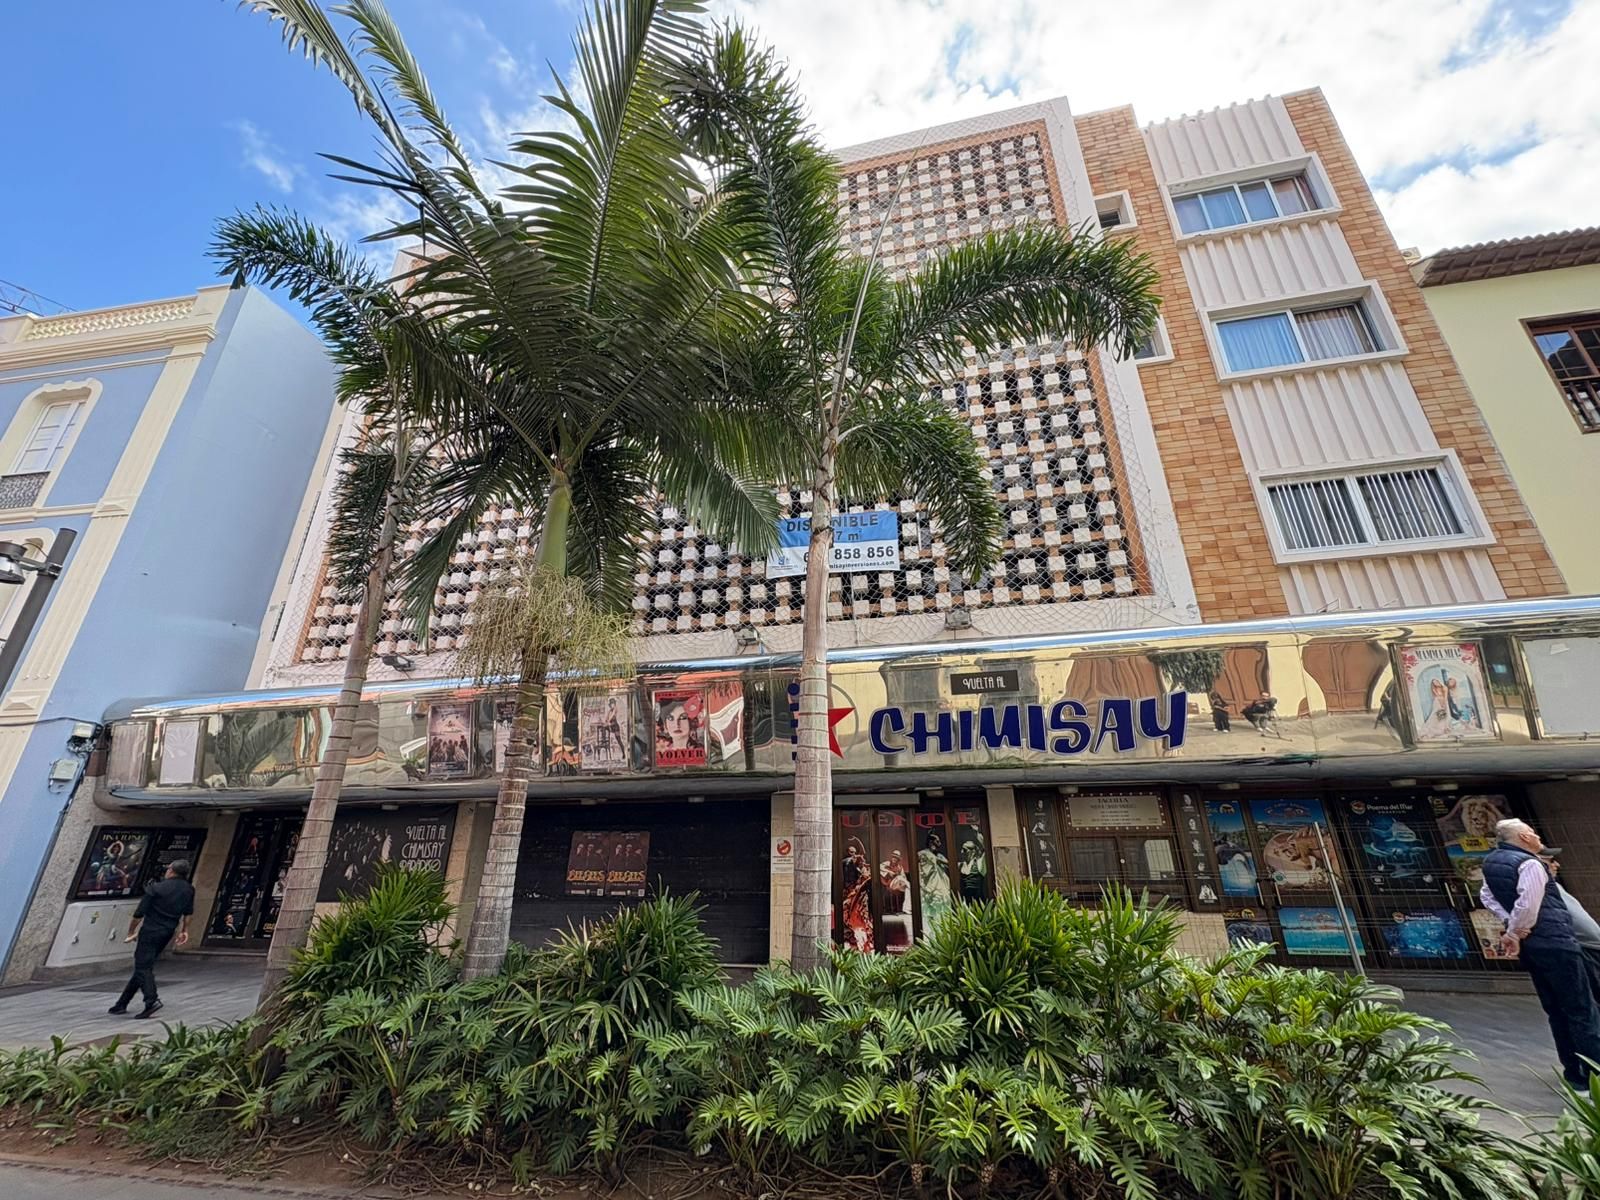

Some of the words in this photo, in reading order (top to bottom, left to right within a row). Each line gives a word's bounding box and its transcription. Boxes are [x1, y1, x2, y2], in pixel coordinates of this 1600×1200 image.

[786, 513, 879, 532] DISNIBLE
[834, 547, 861, 560] 858
[867, 545, 894, 559] 856
[962, 676, 995, 690] VUELTA
[996, 674, 1007, 689] AL
[868, 689, 1189, 755] CHIMISAY
[659, 748, 704, 760] VOLVER
[405, 824, 438, 841] VUELTA
[437, 824, 448, 840] AL
[401, 841, 445, 859] CHIMISAY
